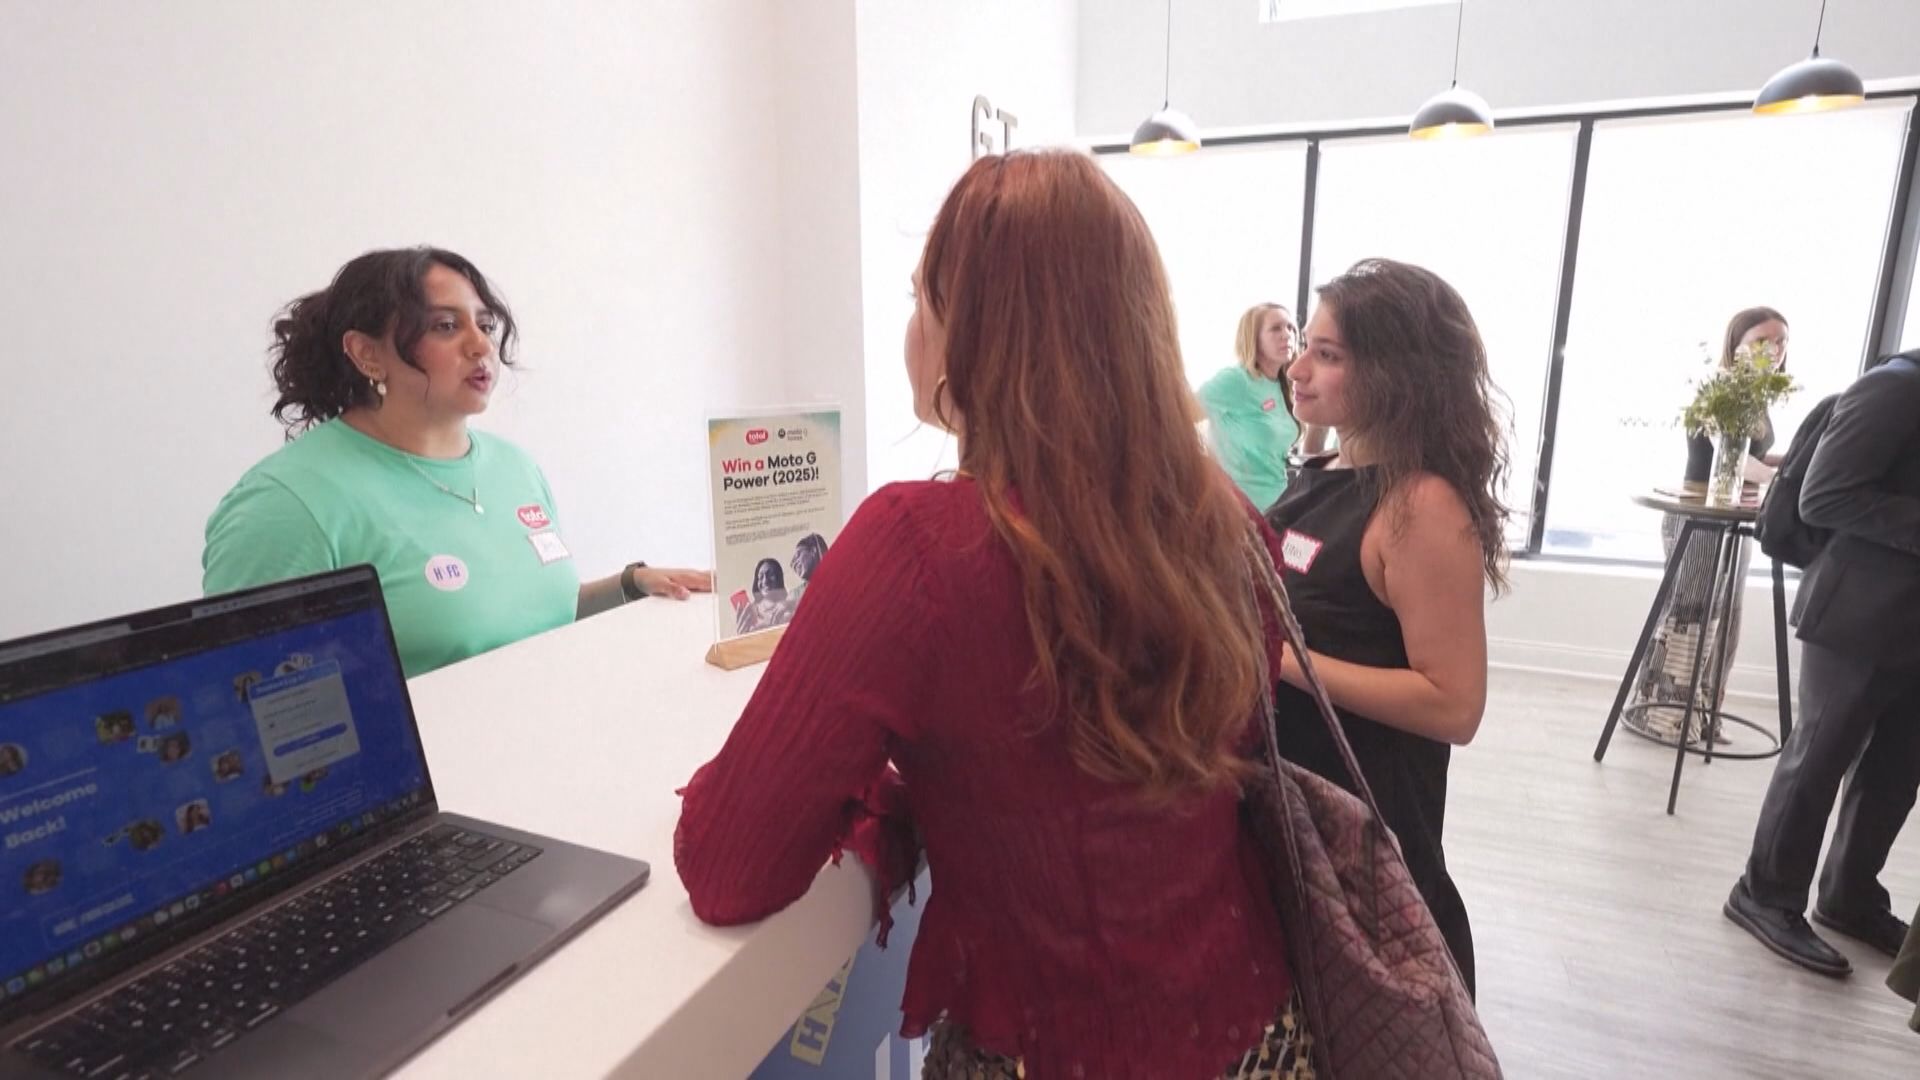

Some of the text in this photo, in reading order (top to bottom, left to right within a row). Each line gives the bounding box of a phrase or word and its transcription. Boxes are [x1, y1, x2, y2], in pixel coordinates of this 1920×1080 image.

[722, 452, 817, 474] Win a Moto G
[723, 467, 819, 491] Power (2025)!
[0, 782, 98, 825] Welcome
[5, 815, 67, 849] Back!
